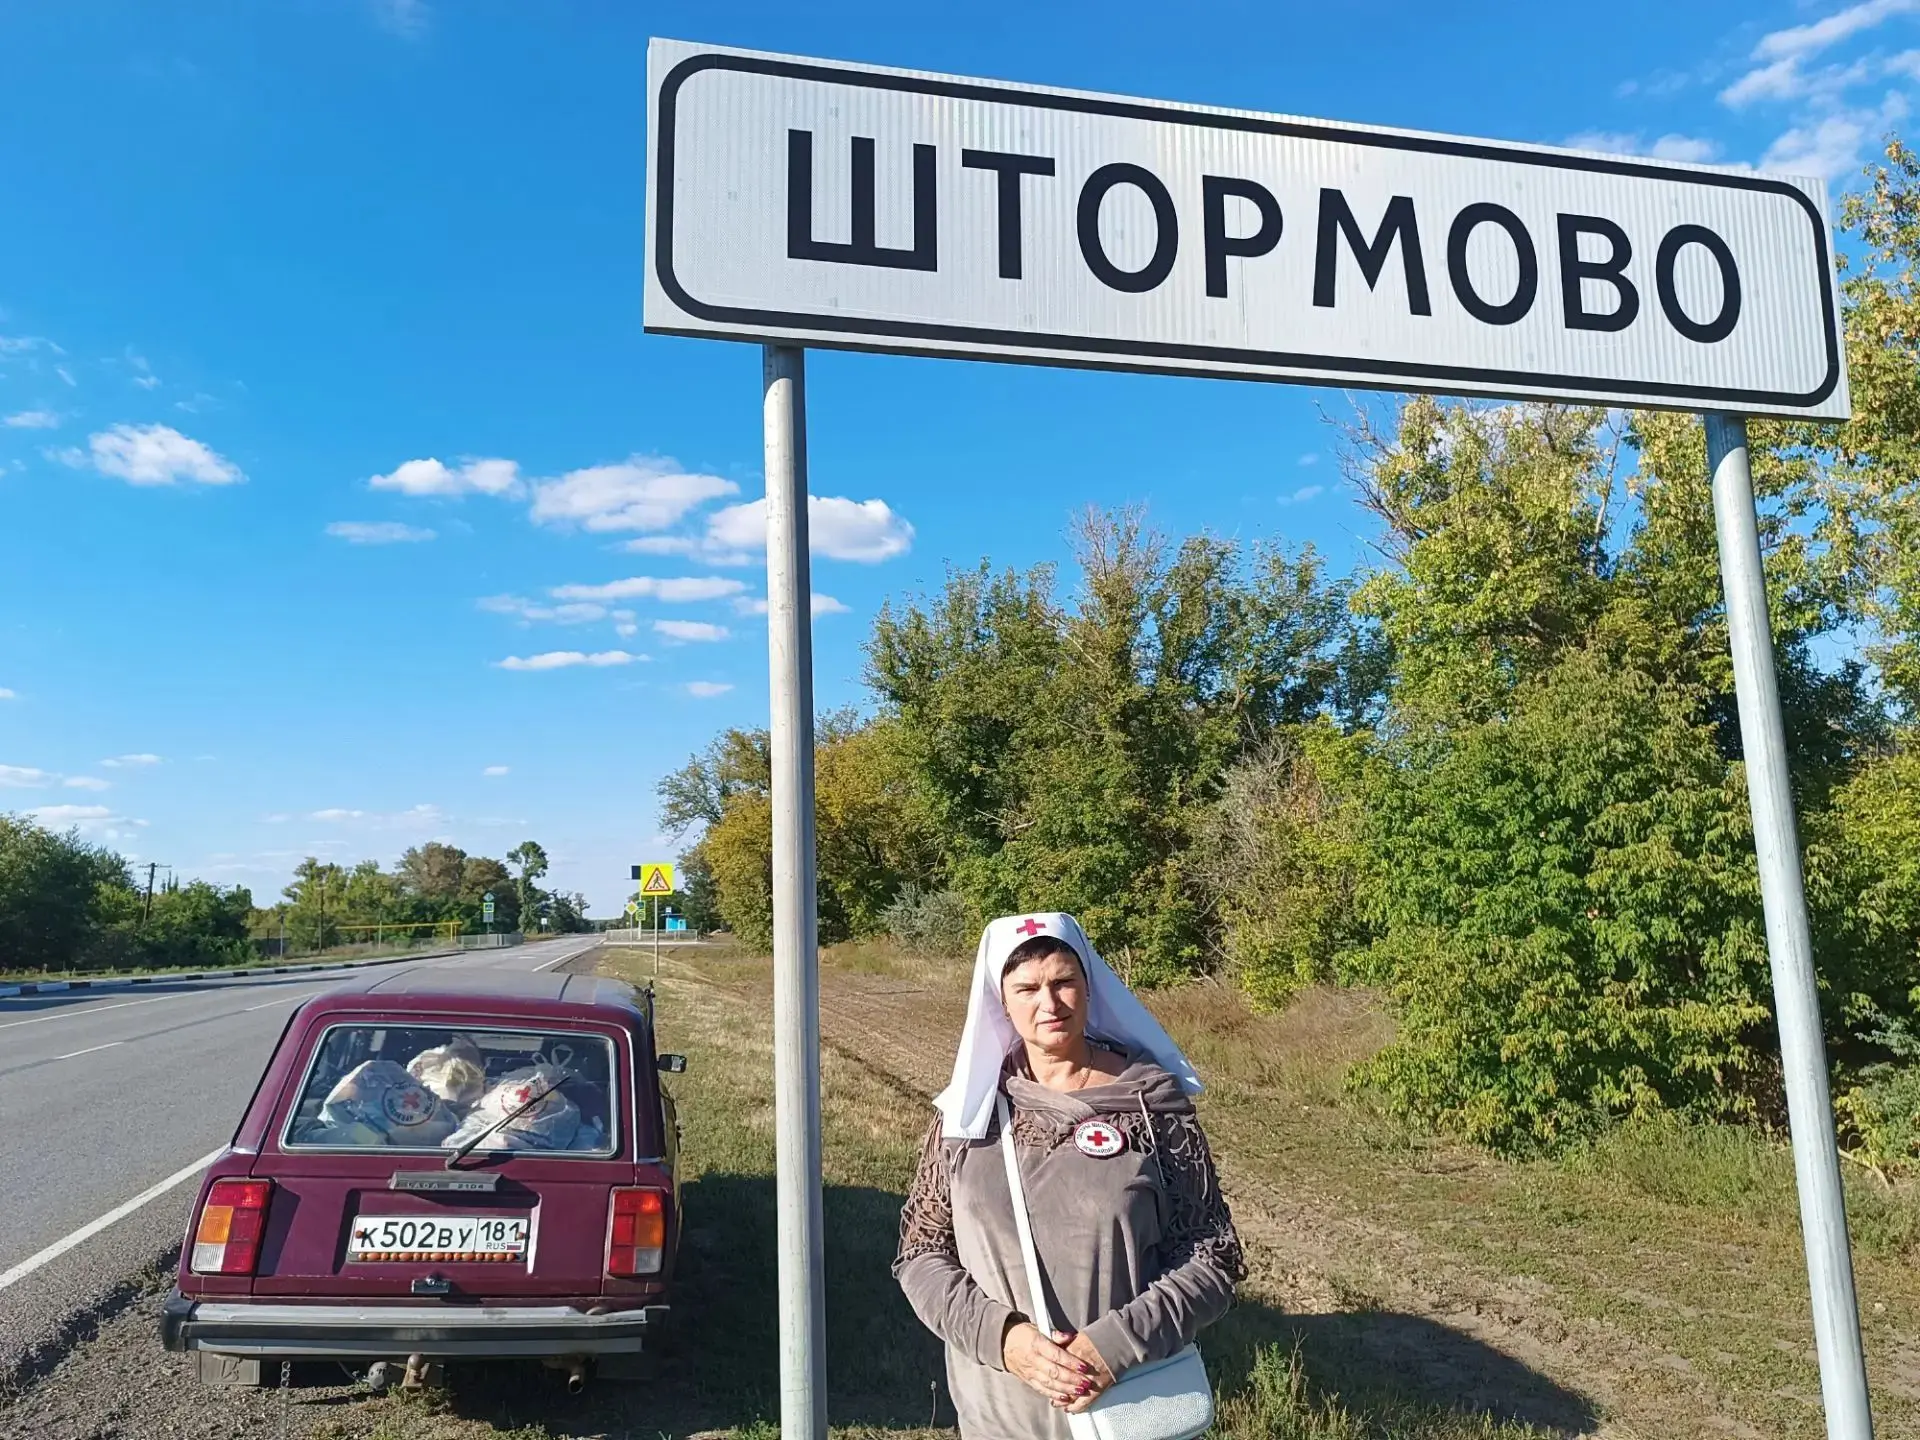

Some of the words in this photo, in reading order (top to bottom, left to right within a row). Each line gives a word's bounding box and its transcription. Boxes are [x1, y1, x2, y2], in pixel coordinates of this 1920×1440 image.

[786, 128, 1742, 344] ШТОРМОВО
[406, 1182, 440, 1190] LADA
[361, 1221, 473, 1248] К502ВУ
[480, 1221, 520, 1242] 181
[486, 1242, 506, 1250] RUS
